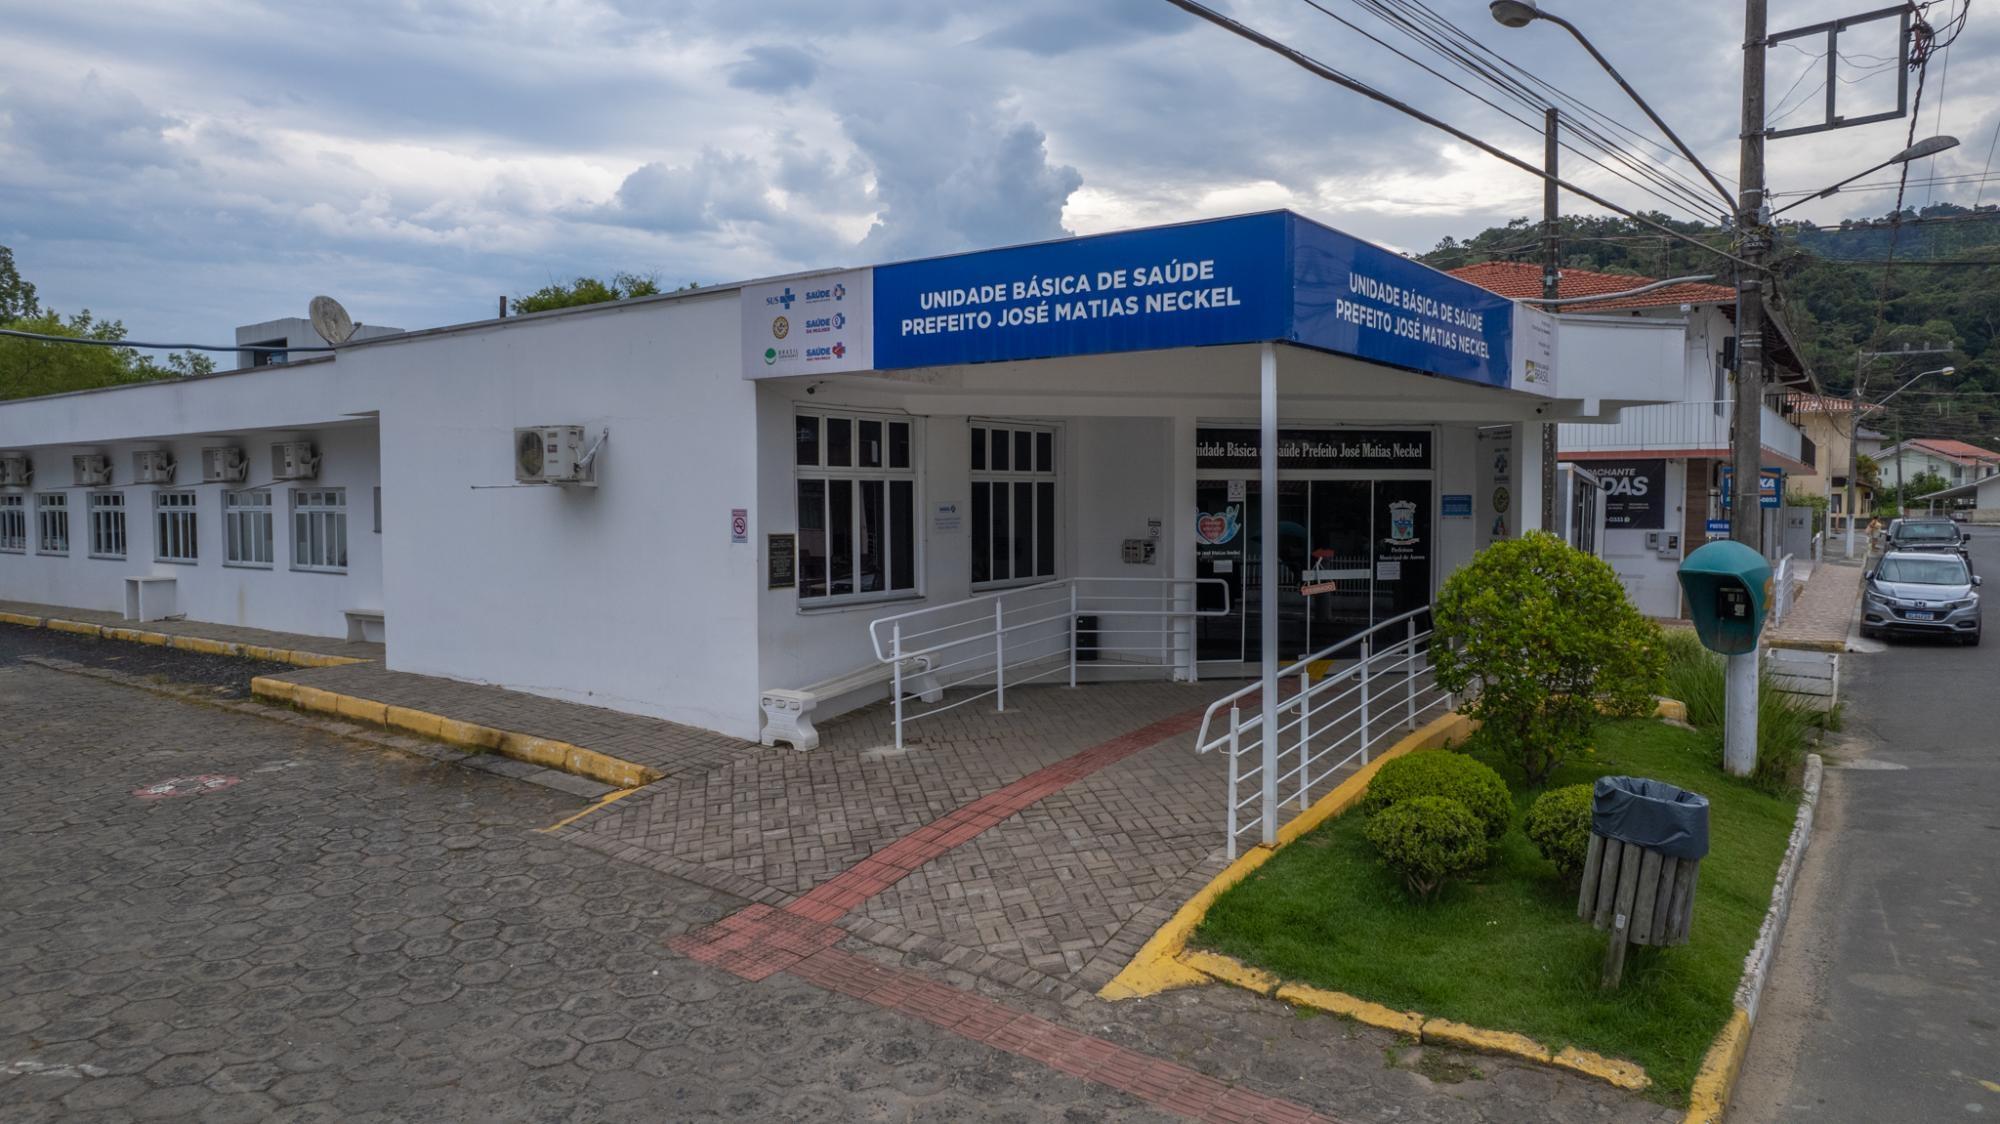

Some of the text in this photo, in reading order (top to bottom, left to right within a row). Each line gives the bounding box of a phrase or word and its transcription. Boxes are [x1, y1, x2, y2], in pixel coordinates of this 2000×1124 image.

[920, 259, 1214, 310] UNIDADE BÁSICA DE SAÚDE
[766, 296, 779, 305] SUS
[806, 289, 830, 300] SAÚDE
[1349, 272, 1483, 332] UNIDADE BÁSICA DE SAÚDE
[901, 286, 1241, 336] PREFEITO JOSÉ MATIAS NECKEL
[806, 318, 830, 328] SAÚDE
[1336, 298, 1490, 359] PREFEITO JOSÉ MATIAS NECKEL
[806, 347, 830, 357] SAÚDE
[1196, 441, 1423, 458] nidade Básica aúde Prefeito José Matias Neckel
[1587, 468, 1636, 476] PACHANTE
[1597, 476, 1649, 496] DAS
